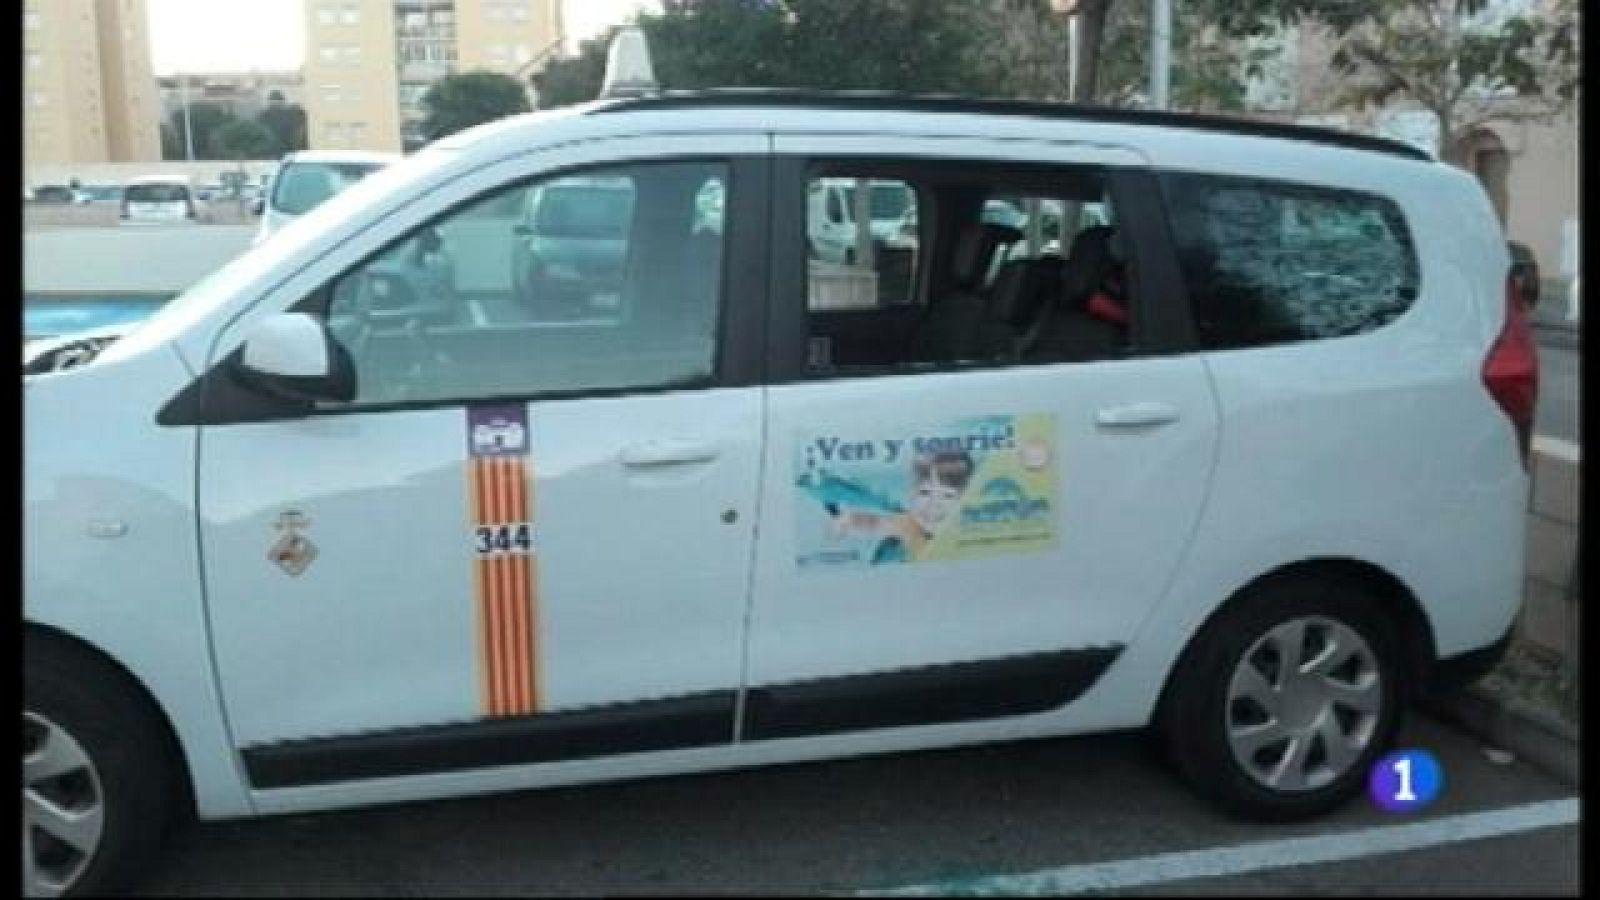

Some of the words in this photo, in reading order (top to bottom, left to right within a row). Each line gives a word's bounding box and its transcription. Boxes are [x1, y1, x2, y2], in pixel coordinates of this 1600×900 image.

[805, 435, 876, 468] ¡Ven
[883, 438, 904, 463] y
[475, 523, 531, 553] 344
